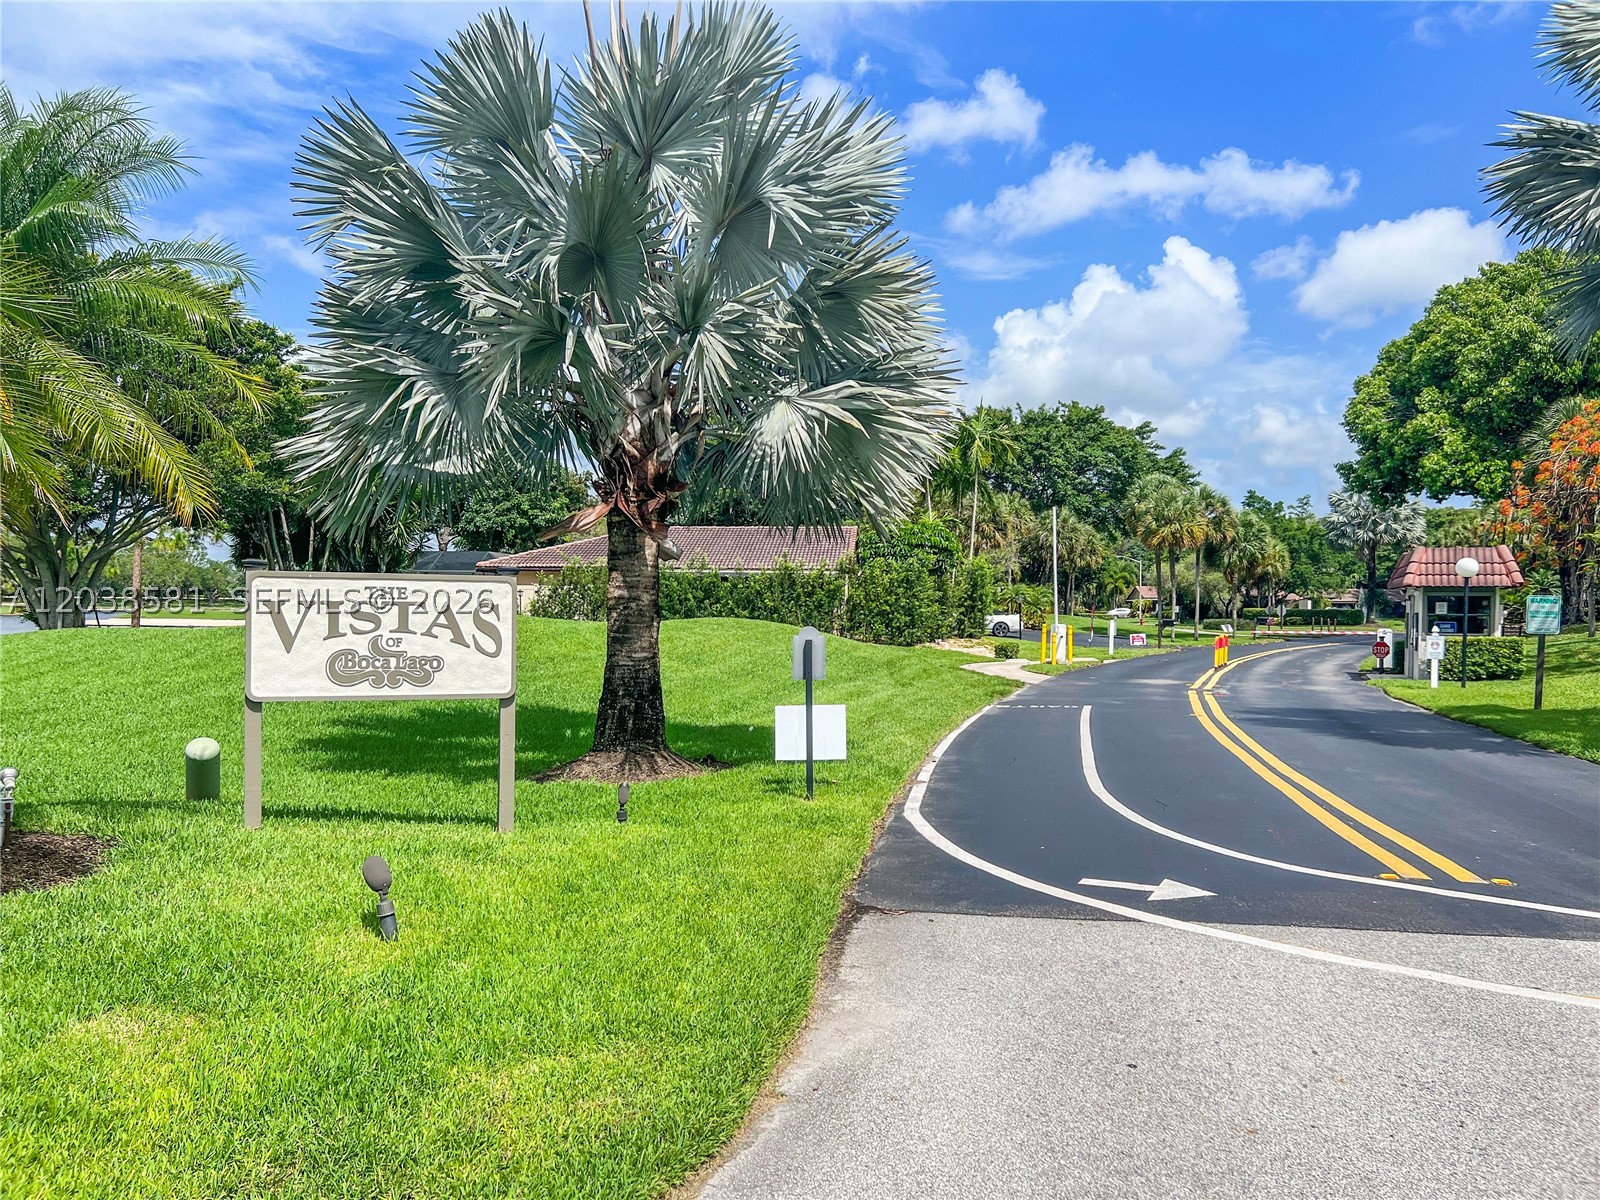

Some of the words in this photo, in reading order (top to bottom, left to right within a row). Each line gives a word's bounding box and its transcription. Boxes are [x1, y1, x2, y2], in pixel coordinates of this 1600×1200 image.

[364, 586, 409, 600] THE
[262, 599, 503, 658] VISTAS
[385, 637, 403, 648] OF
[1373, 646, 1389, 654] STOP
[339, 652, 392, 670] Boca
[393, 652, 443, 672] Lago
